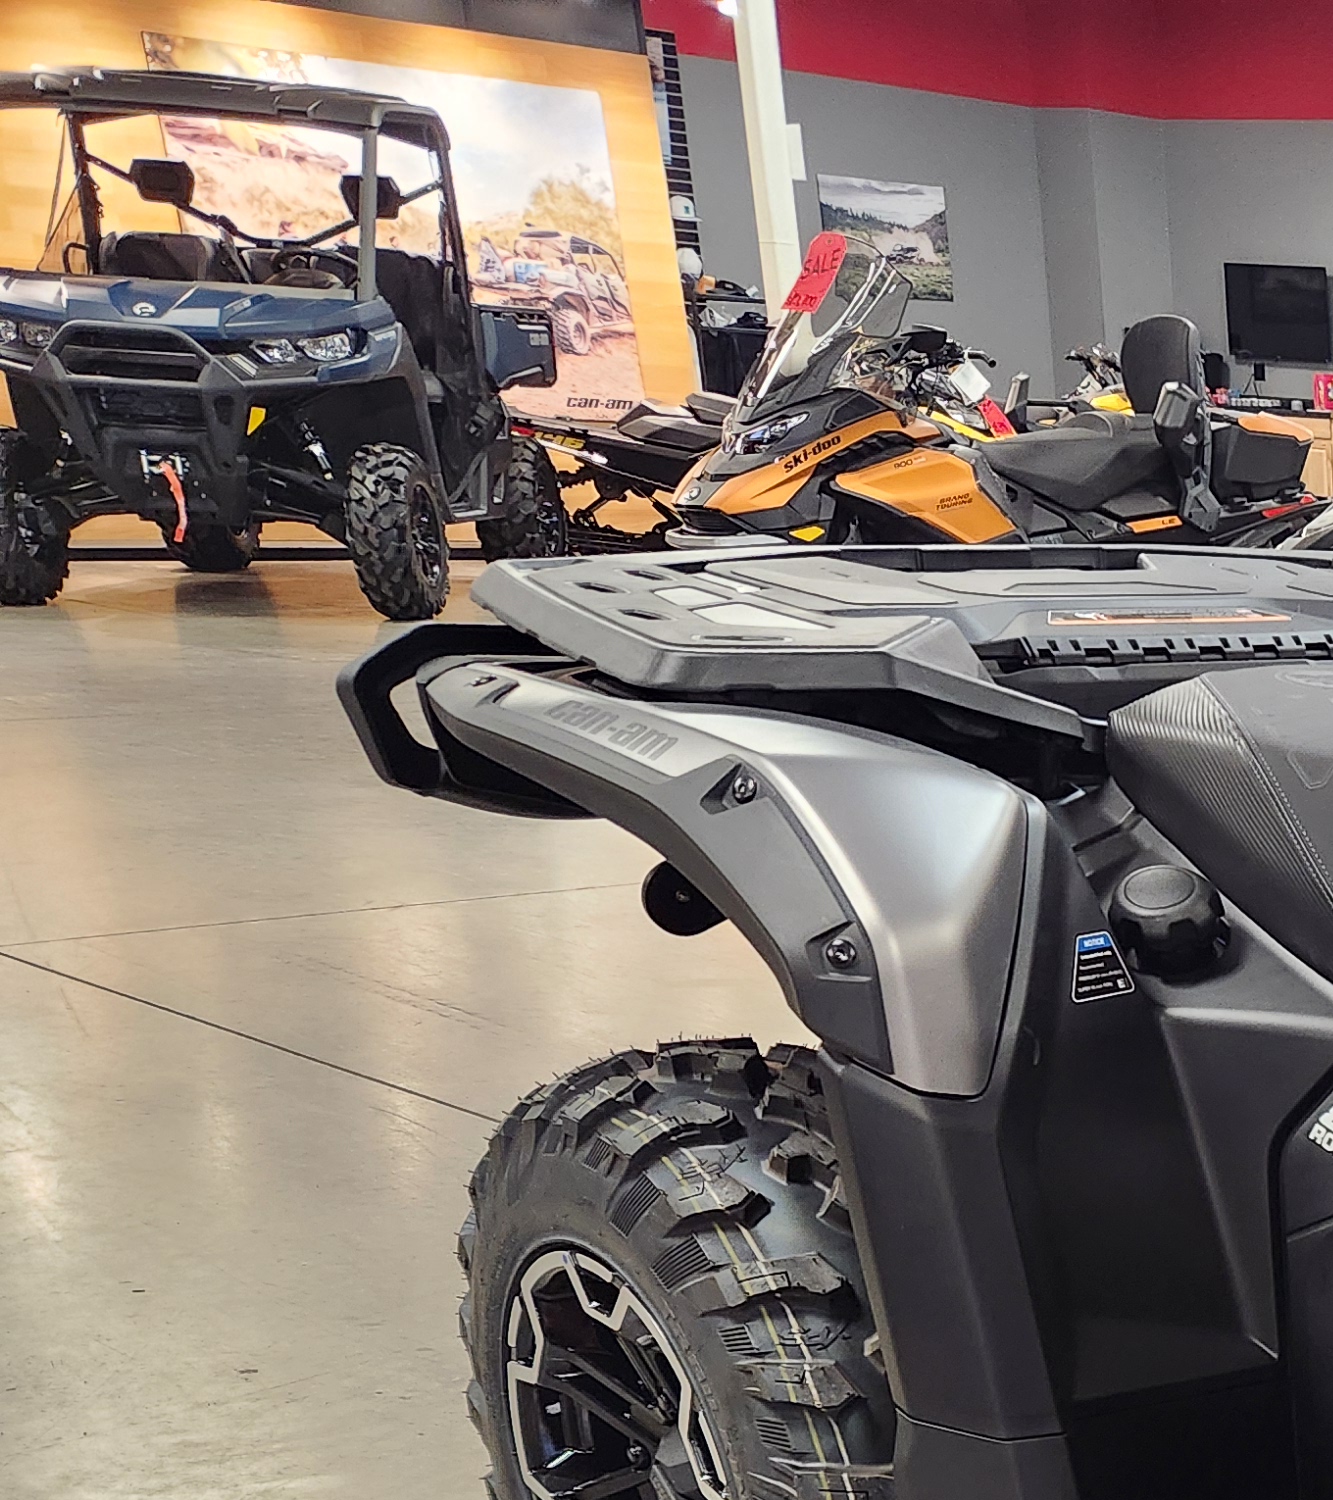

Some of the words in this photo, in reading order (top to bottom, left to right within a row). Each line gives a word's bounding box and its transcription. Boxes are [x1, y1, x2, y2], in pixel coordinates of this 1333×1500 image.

[800, 247, 841, 280] SALE
[566, 397, 633, 410] can-am
[783, 436, 841, 473] ski-doo
[939, 493, 970, 504] GRAND
[543, 699, 679, 761] can-am
